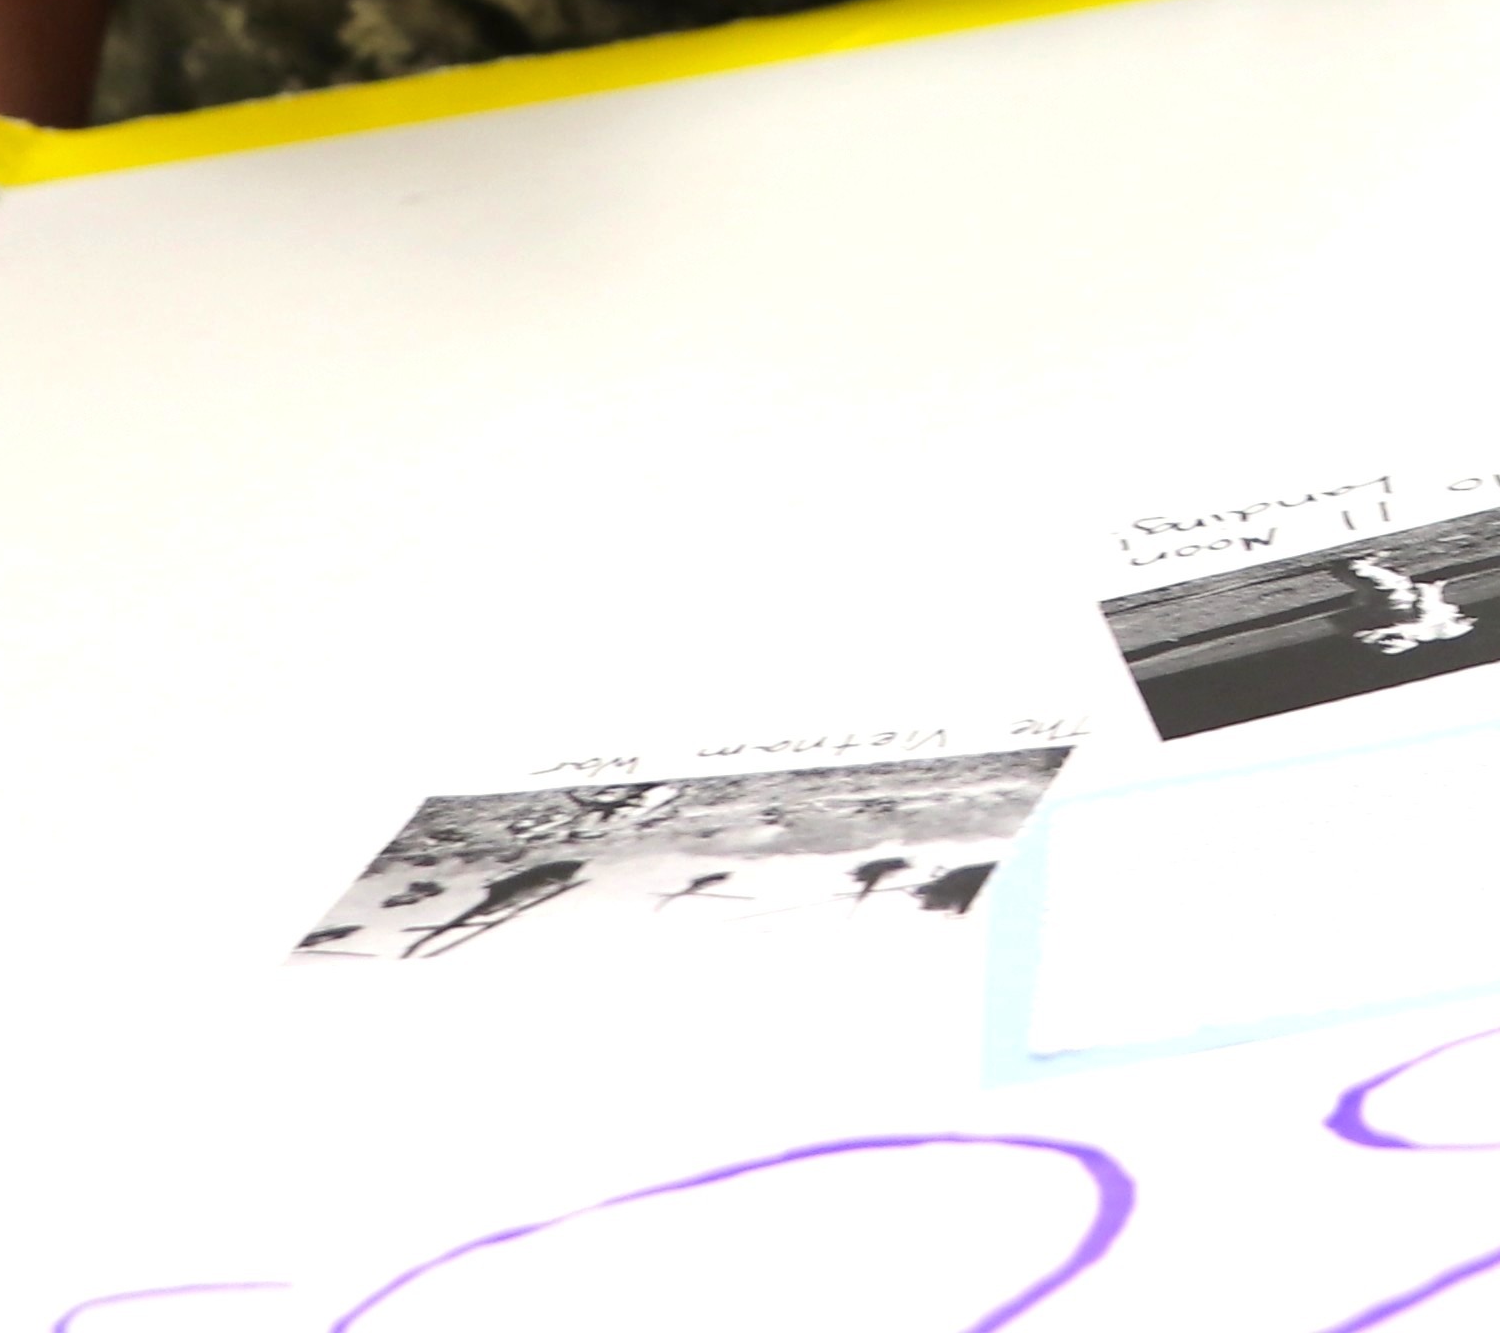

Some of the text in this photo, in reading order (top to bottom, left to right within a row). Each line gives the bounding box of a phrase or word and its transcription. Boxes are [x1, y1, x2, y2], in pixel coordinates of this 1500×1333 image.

[1340, 501, 1391, 531] 11
[1127, 527, 1277, 569] Moon
[528, 715, 1091, 778] The Vietnam War
